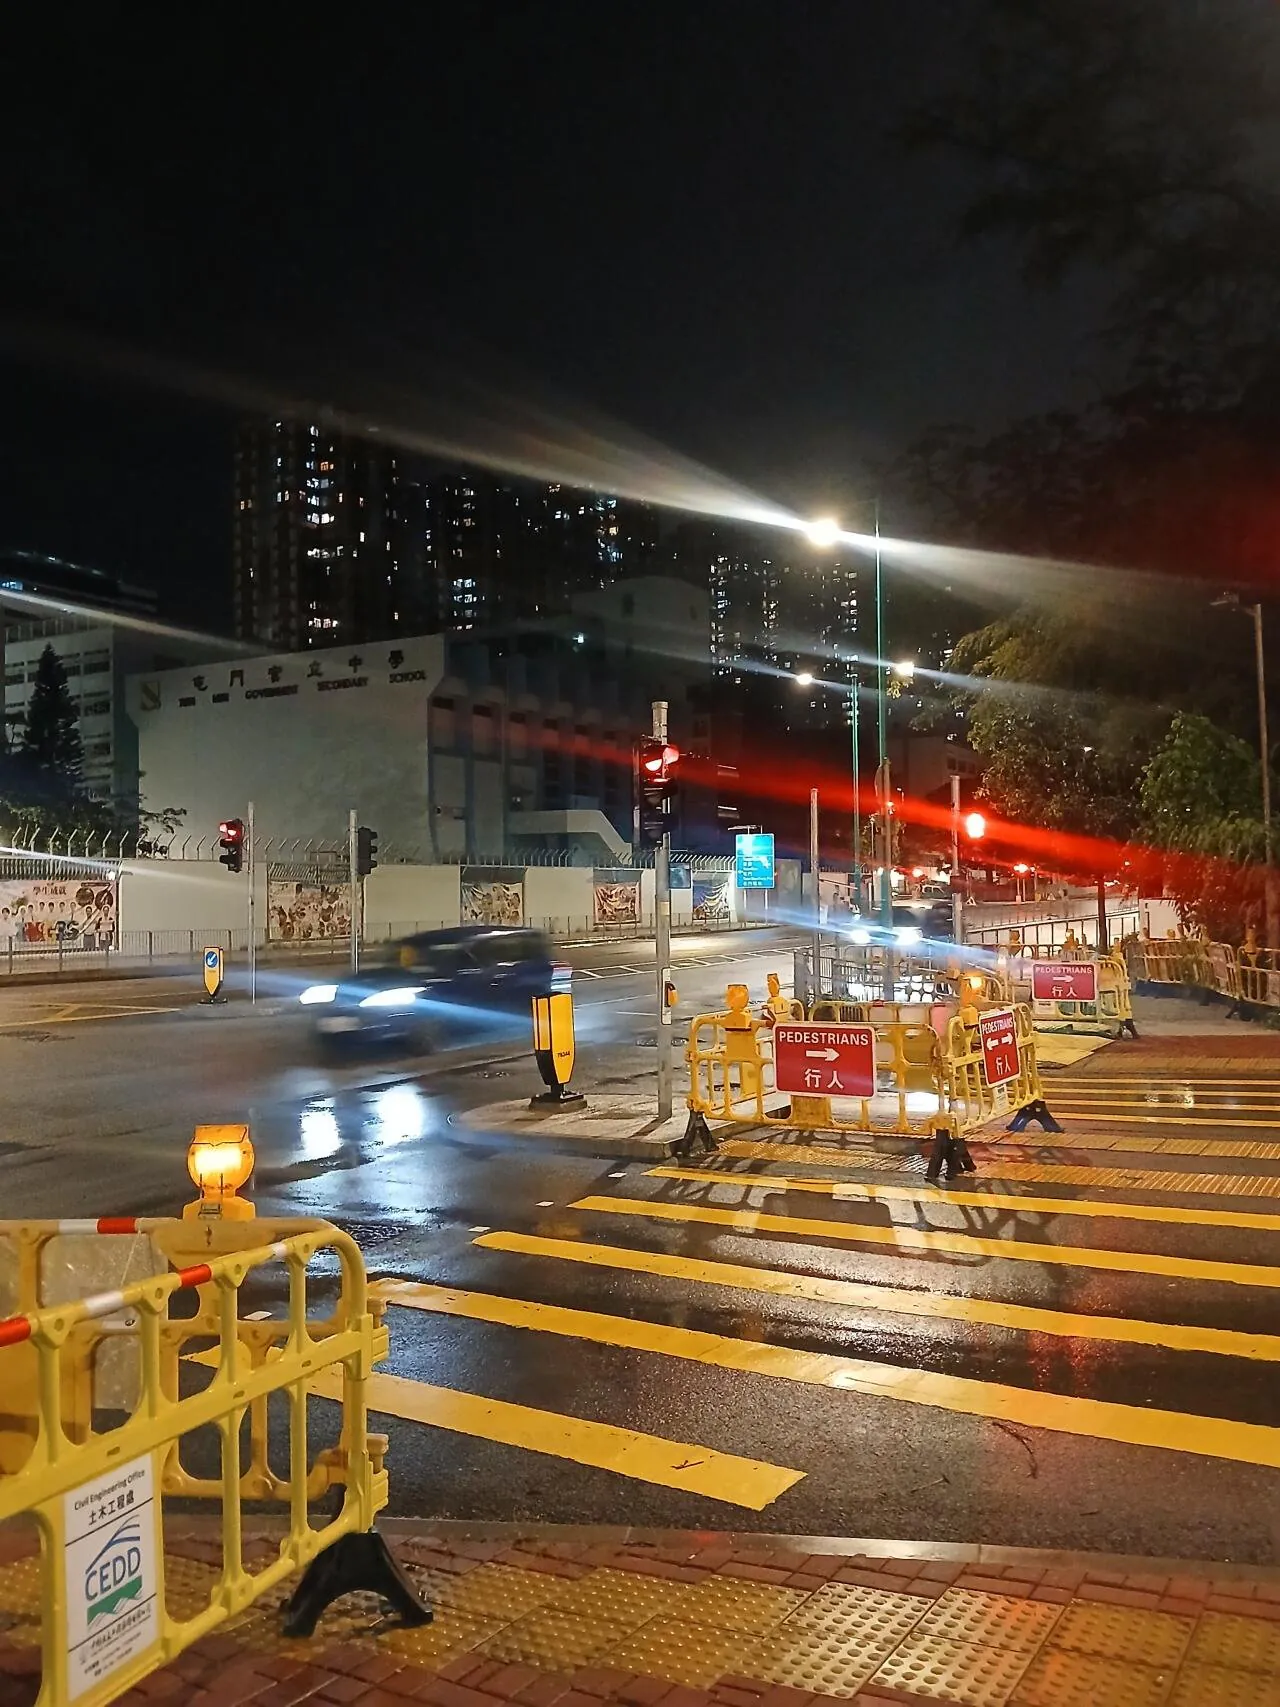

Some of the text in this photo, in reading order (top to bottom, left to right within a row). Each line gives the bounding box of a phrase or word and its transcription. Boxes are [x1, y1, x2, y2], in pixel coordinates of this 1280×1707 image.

[389, 669, 427, 684] SCHOOL
[1035, 966, 1093, 974] PEDESTRIANS
[1052, 985, 1077, 997] 行人
[981, 1016, 1014, 1035] PEDESTRIANS
[779, 1031, 869, 1046] PEDESTRIANS
[995, 1053, 1012, 1076] 行人
[804, 1068, 844, 1089] 行人
[74, 1469, 145, 1511] Civil Engineering Office
[88, 1489, 134, 1526] 土木工程處
[84, 1546, 141, 1602] CEDD
